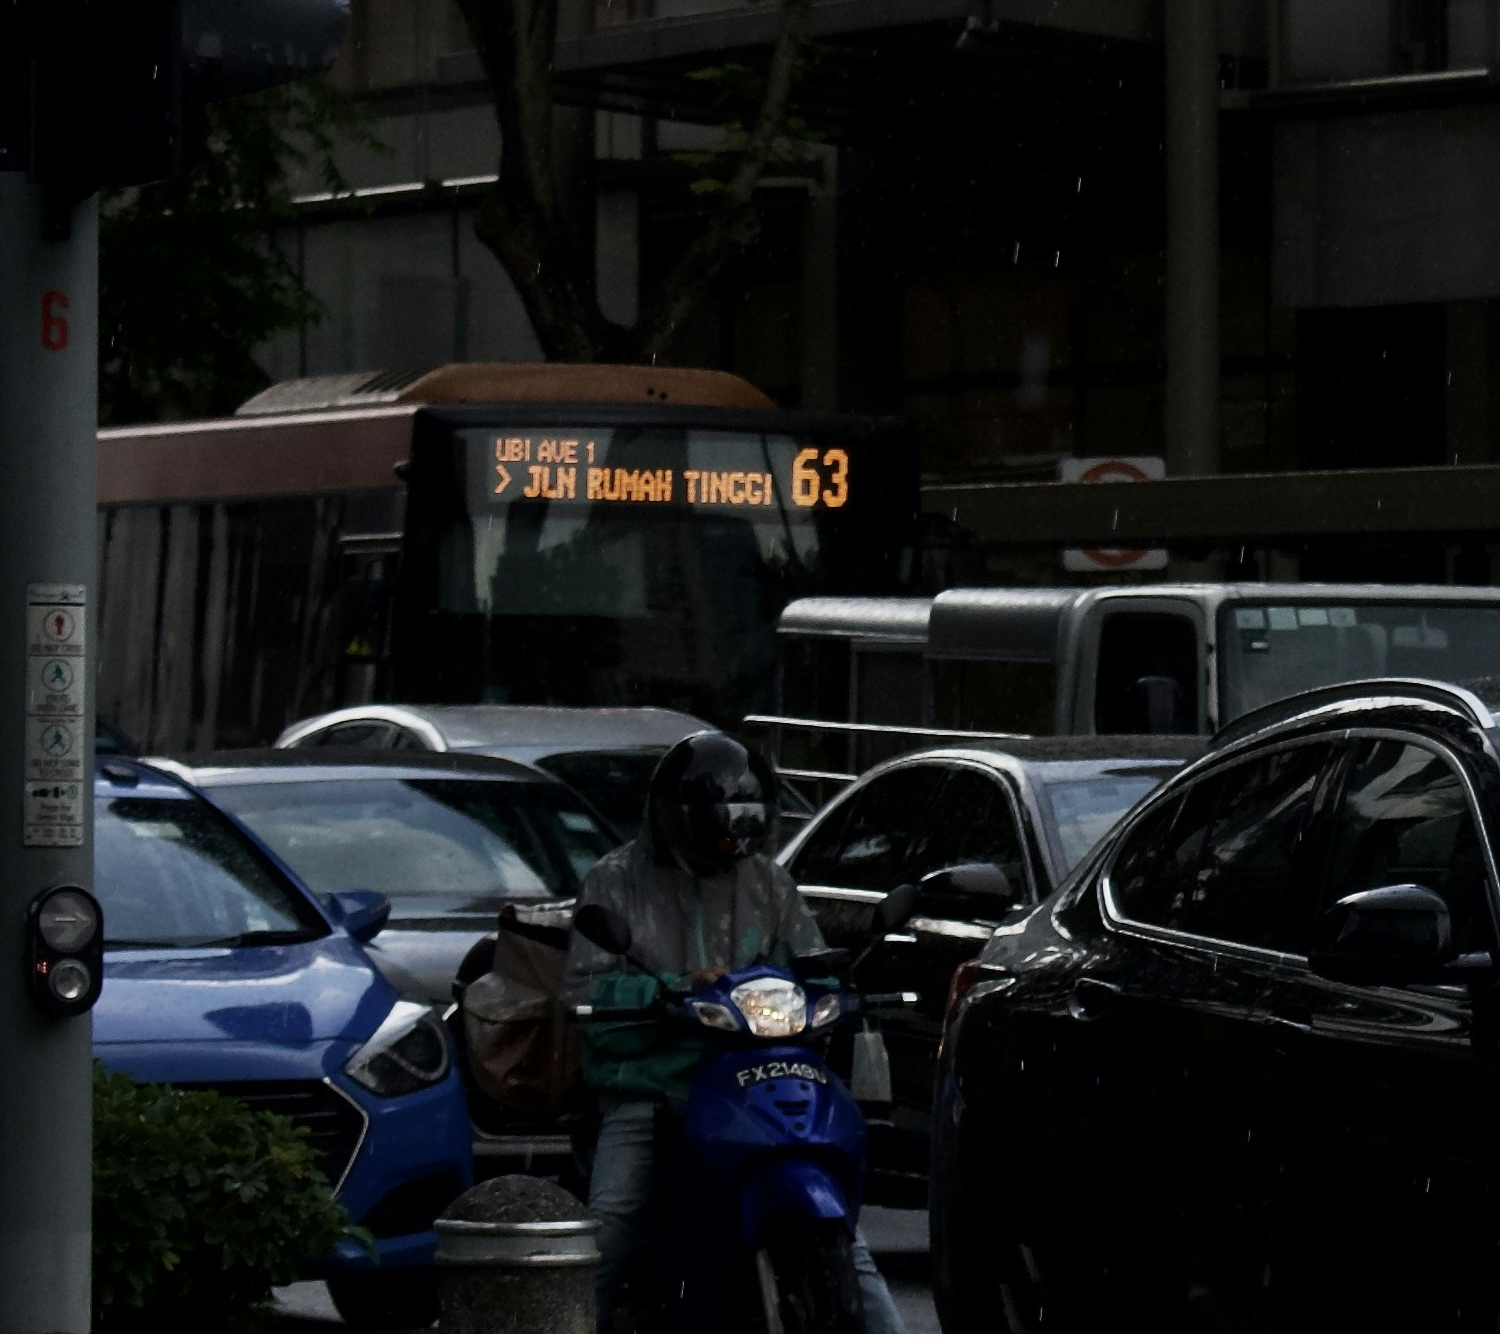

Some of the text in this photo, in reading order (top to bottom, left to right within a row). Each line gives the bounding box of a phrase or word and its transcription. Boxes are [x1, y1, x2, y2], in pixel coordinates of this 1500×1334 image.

[40, 290, 68, 351] 6
[494, 438, 595, 465] UBI AVE 1
[522, 465, 773, 506] JLN RUMAH TINGGI
[792, 447, 850, 508] 63
